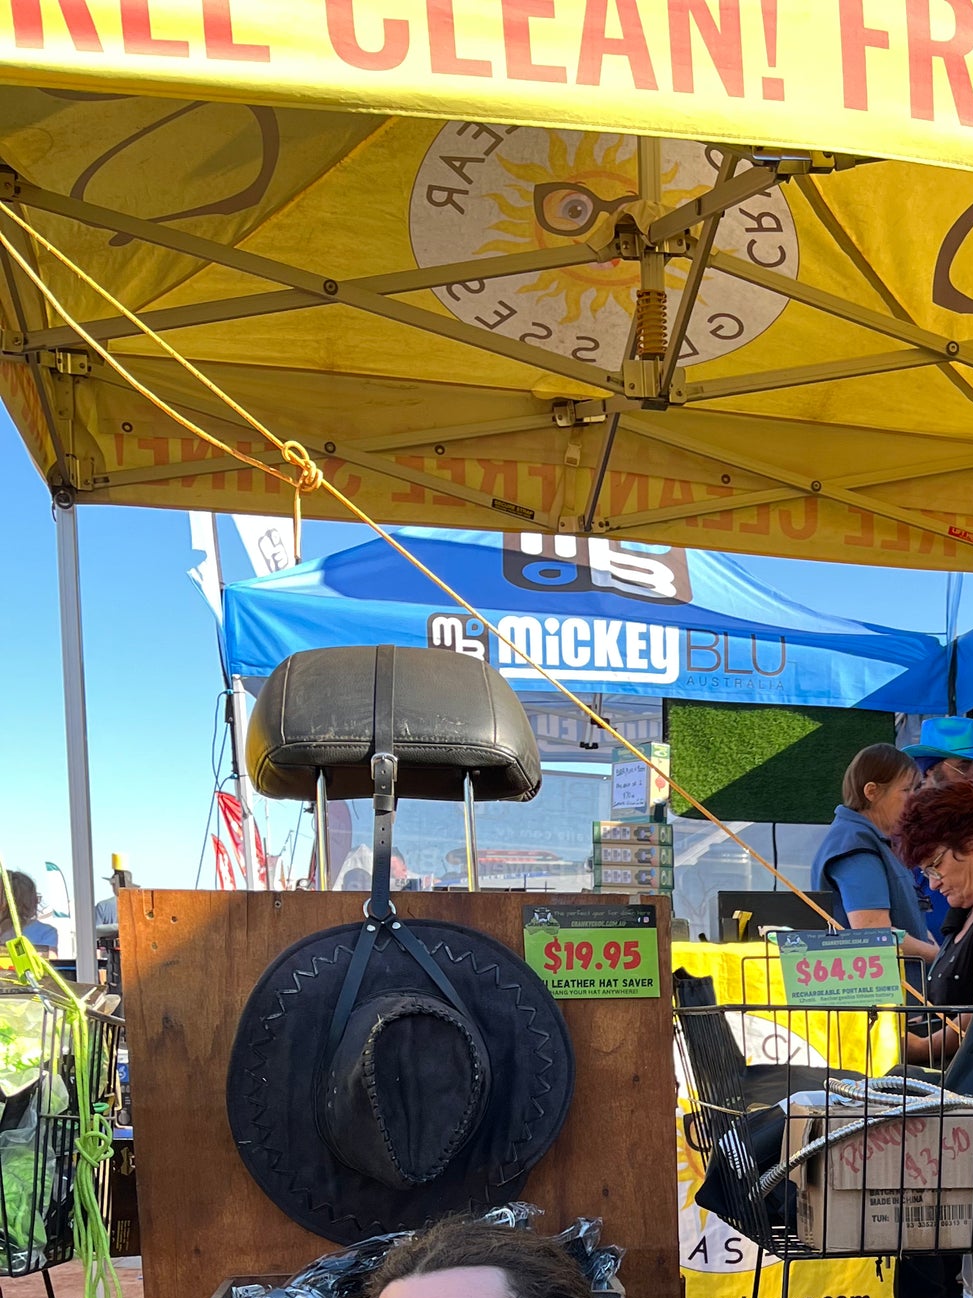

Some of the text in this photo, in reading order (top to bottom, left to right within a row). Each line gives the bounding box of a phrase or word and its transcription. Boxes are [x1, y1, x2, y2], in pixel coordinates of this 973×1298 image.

[686, 629, 786, 676] BLU
[686, 676, 785, 690] AUSTRALIA
[544, 936, 641, 974] $19.95
[796, 956, 884, 986] $64.95
[552, 979, 595, 988] LEATHER
[600, 979, 618, 988] HAT
[622, 978, 653, 988] SAVER
[792, 985, 899, 998] RECHARGEABLE PORTABLE SHOWER
[870, 1195, 923, 1206] MADE IN CHINA
[872, 1215, 890, 1223] TUN:
